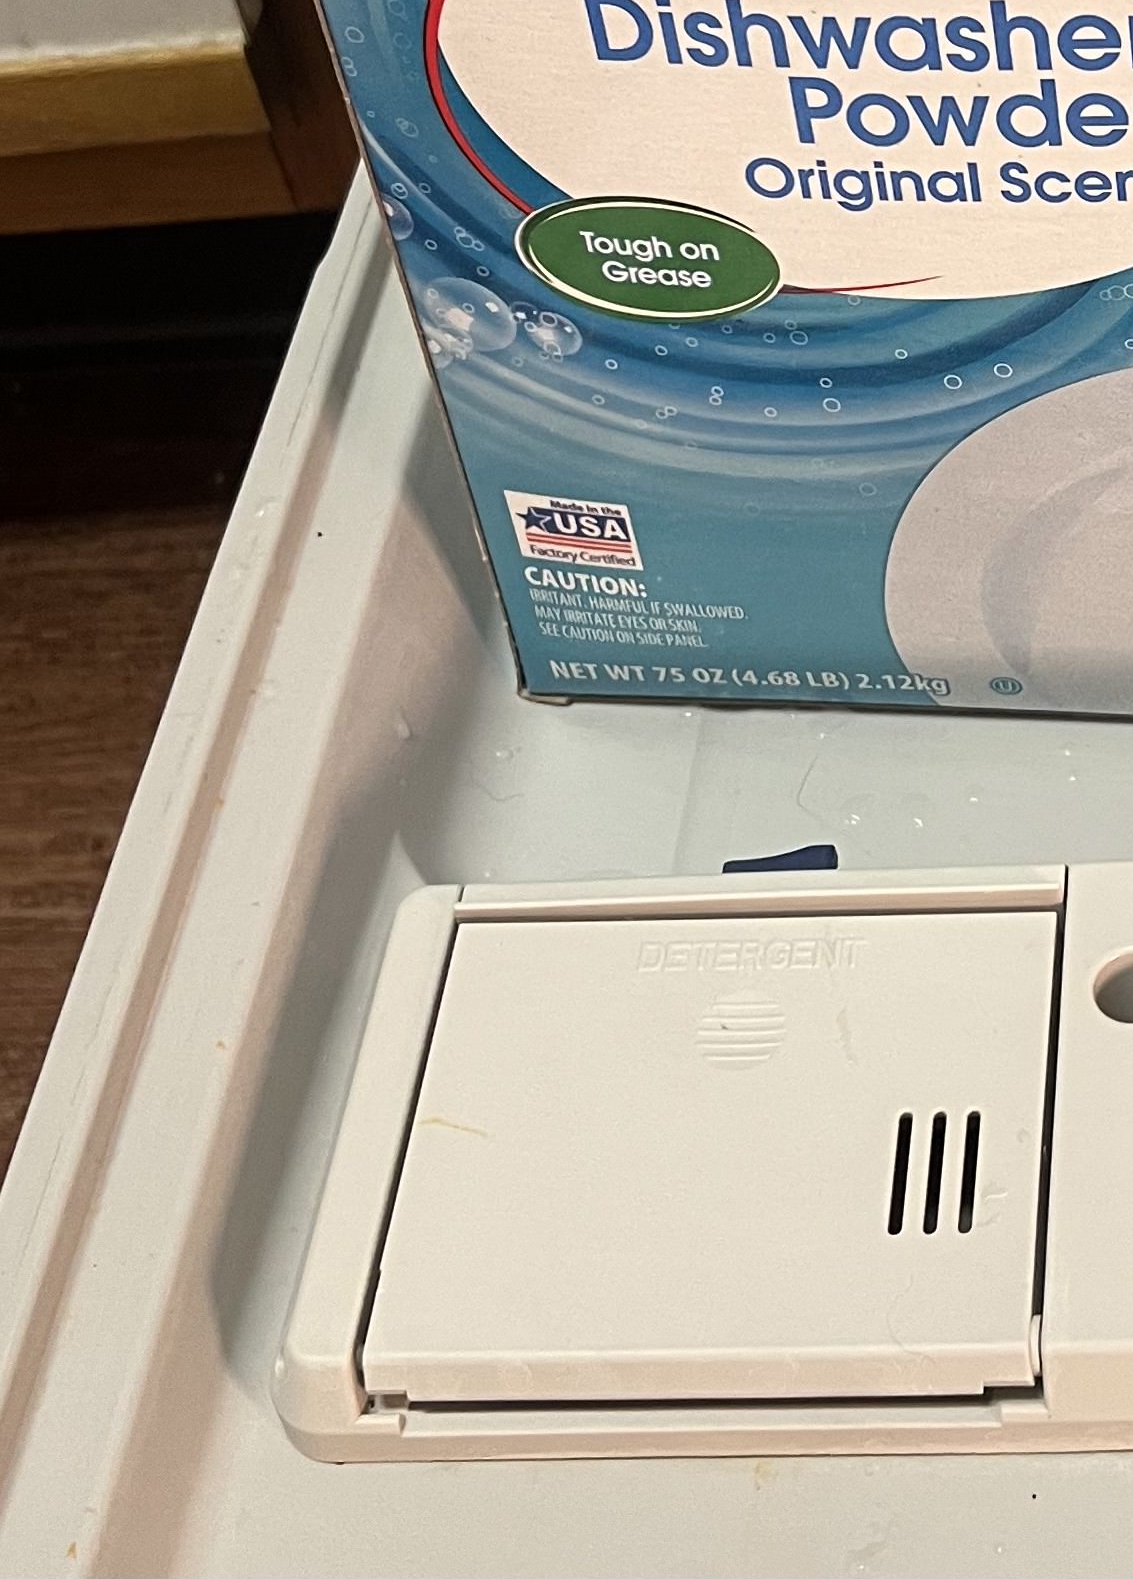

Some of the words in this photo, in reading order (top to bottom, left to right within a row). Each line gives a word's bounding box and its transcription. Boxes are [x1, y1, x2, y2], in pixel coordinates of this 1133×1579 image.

[745, 157, 982, 212] Original
[579, 230, 673, 262] Tough
[679, 242, 720, 261] on
[601, 260, 712, 288] Grease
[550, 500, 584, 512] Made
[553, 512, 628, 540] USA
[530, 545, 578, 563] Factory
[580, 551, 636, 567] Certified
[524, 566, 648, 598] CAUTION:
[534, 604, 561, 621] MAY
[563, 609, 617, 628] IRRITATE
[618, 614, 648, 630] EYES
[649, 617, 668, 631] OR
[588, 595, 650, 615] HARMFUL
[650, 601, 661, 615] IF
[538, 621, 561, 637] SEE
[561, 625, 615, 643] CAUTION
[616, 630, 636, 645] ON
[636, 631, 665, 646] SIDE
[549, 659, 598, 681] NET
[603, 663, 645, 682] WT
[652, 666, 686, 683] 75
[692, 667, 728, 685] OZ
[731, 668, 801, 687] (4.68
[805, 671, 850, 690] LB)
[855, 673, 950, 696] 2.12kg
[637, 937, 870, 972] DETERGENT
